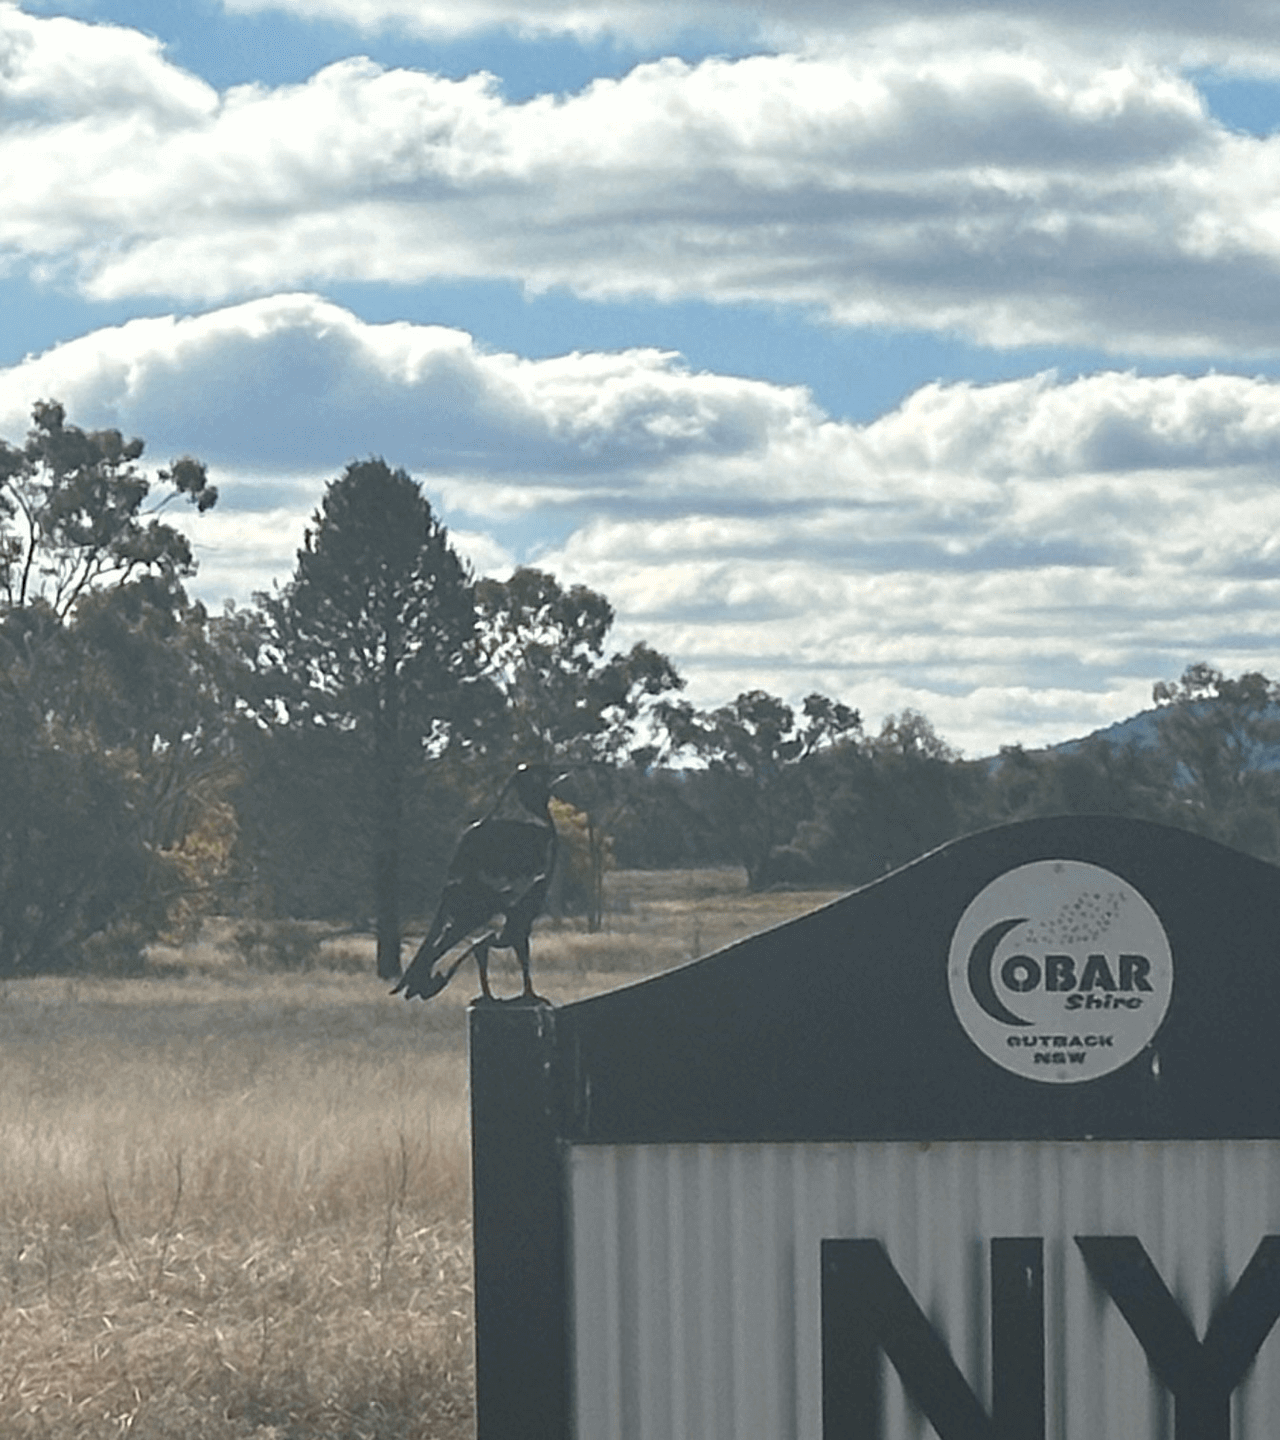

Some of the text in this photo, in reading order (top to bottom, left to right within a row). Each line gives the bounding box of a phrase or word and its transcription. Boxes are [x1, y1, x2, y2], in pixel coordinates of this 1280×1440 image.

[968, 918, 1154, 1027] COBAR
[1064, 994, 1143, 1010] Shire
[1007, 1035, 1114, 1048] OUTBACK
[1034, 1052, 1087, 1065] NSW
